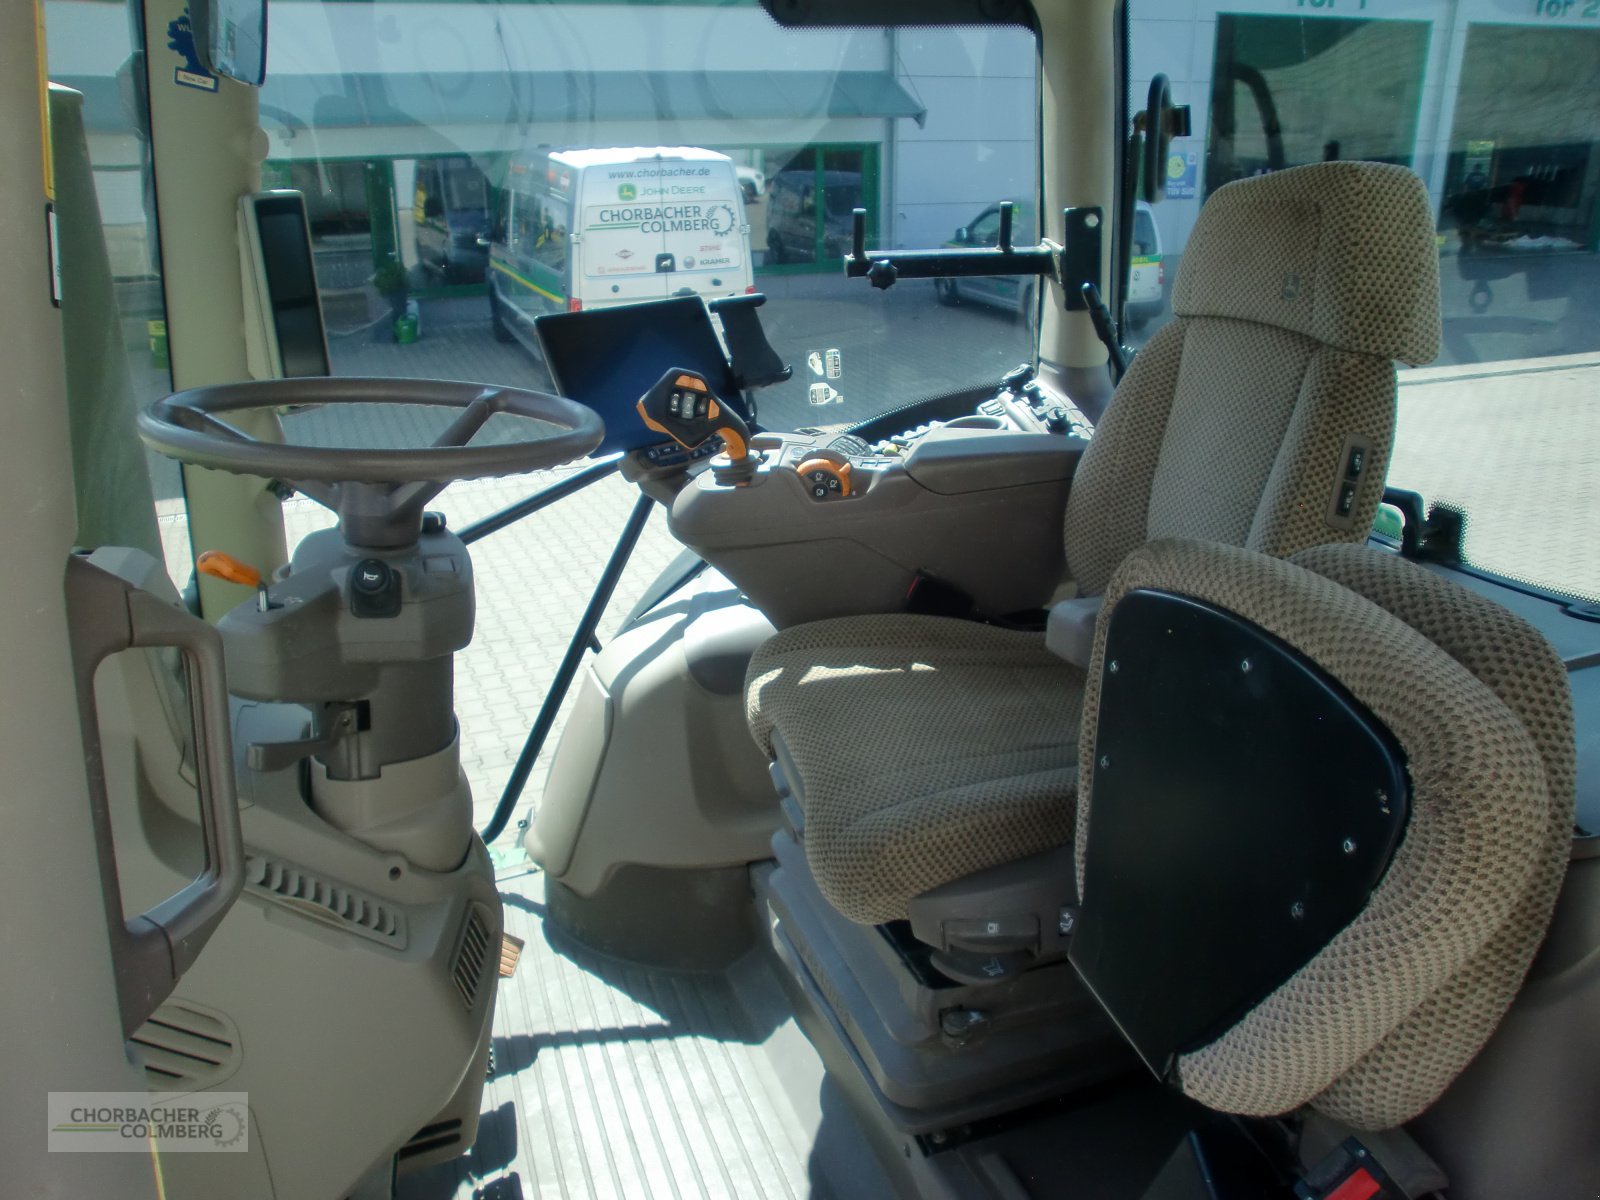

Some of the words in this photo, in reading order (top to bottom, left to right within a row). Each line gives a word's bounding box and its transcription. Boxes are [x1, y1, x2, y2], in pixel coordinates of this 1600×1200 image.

[608, 167, 711, 179] www.chorbacher.de
[640, 187, 670, 196] JOHN
[671, 186, 706, 195] DEERE
[600, 206, 702, 223] CHORBACHER
[641, 218, 720, 234] COLMBERG
